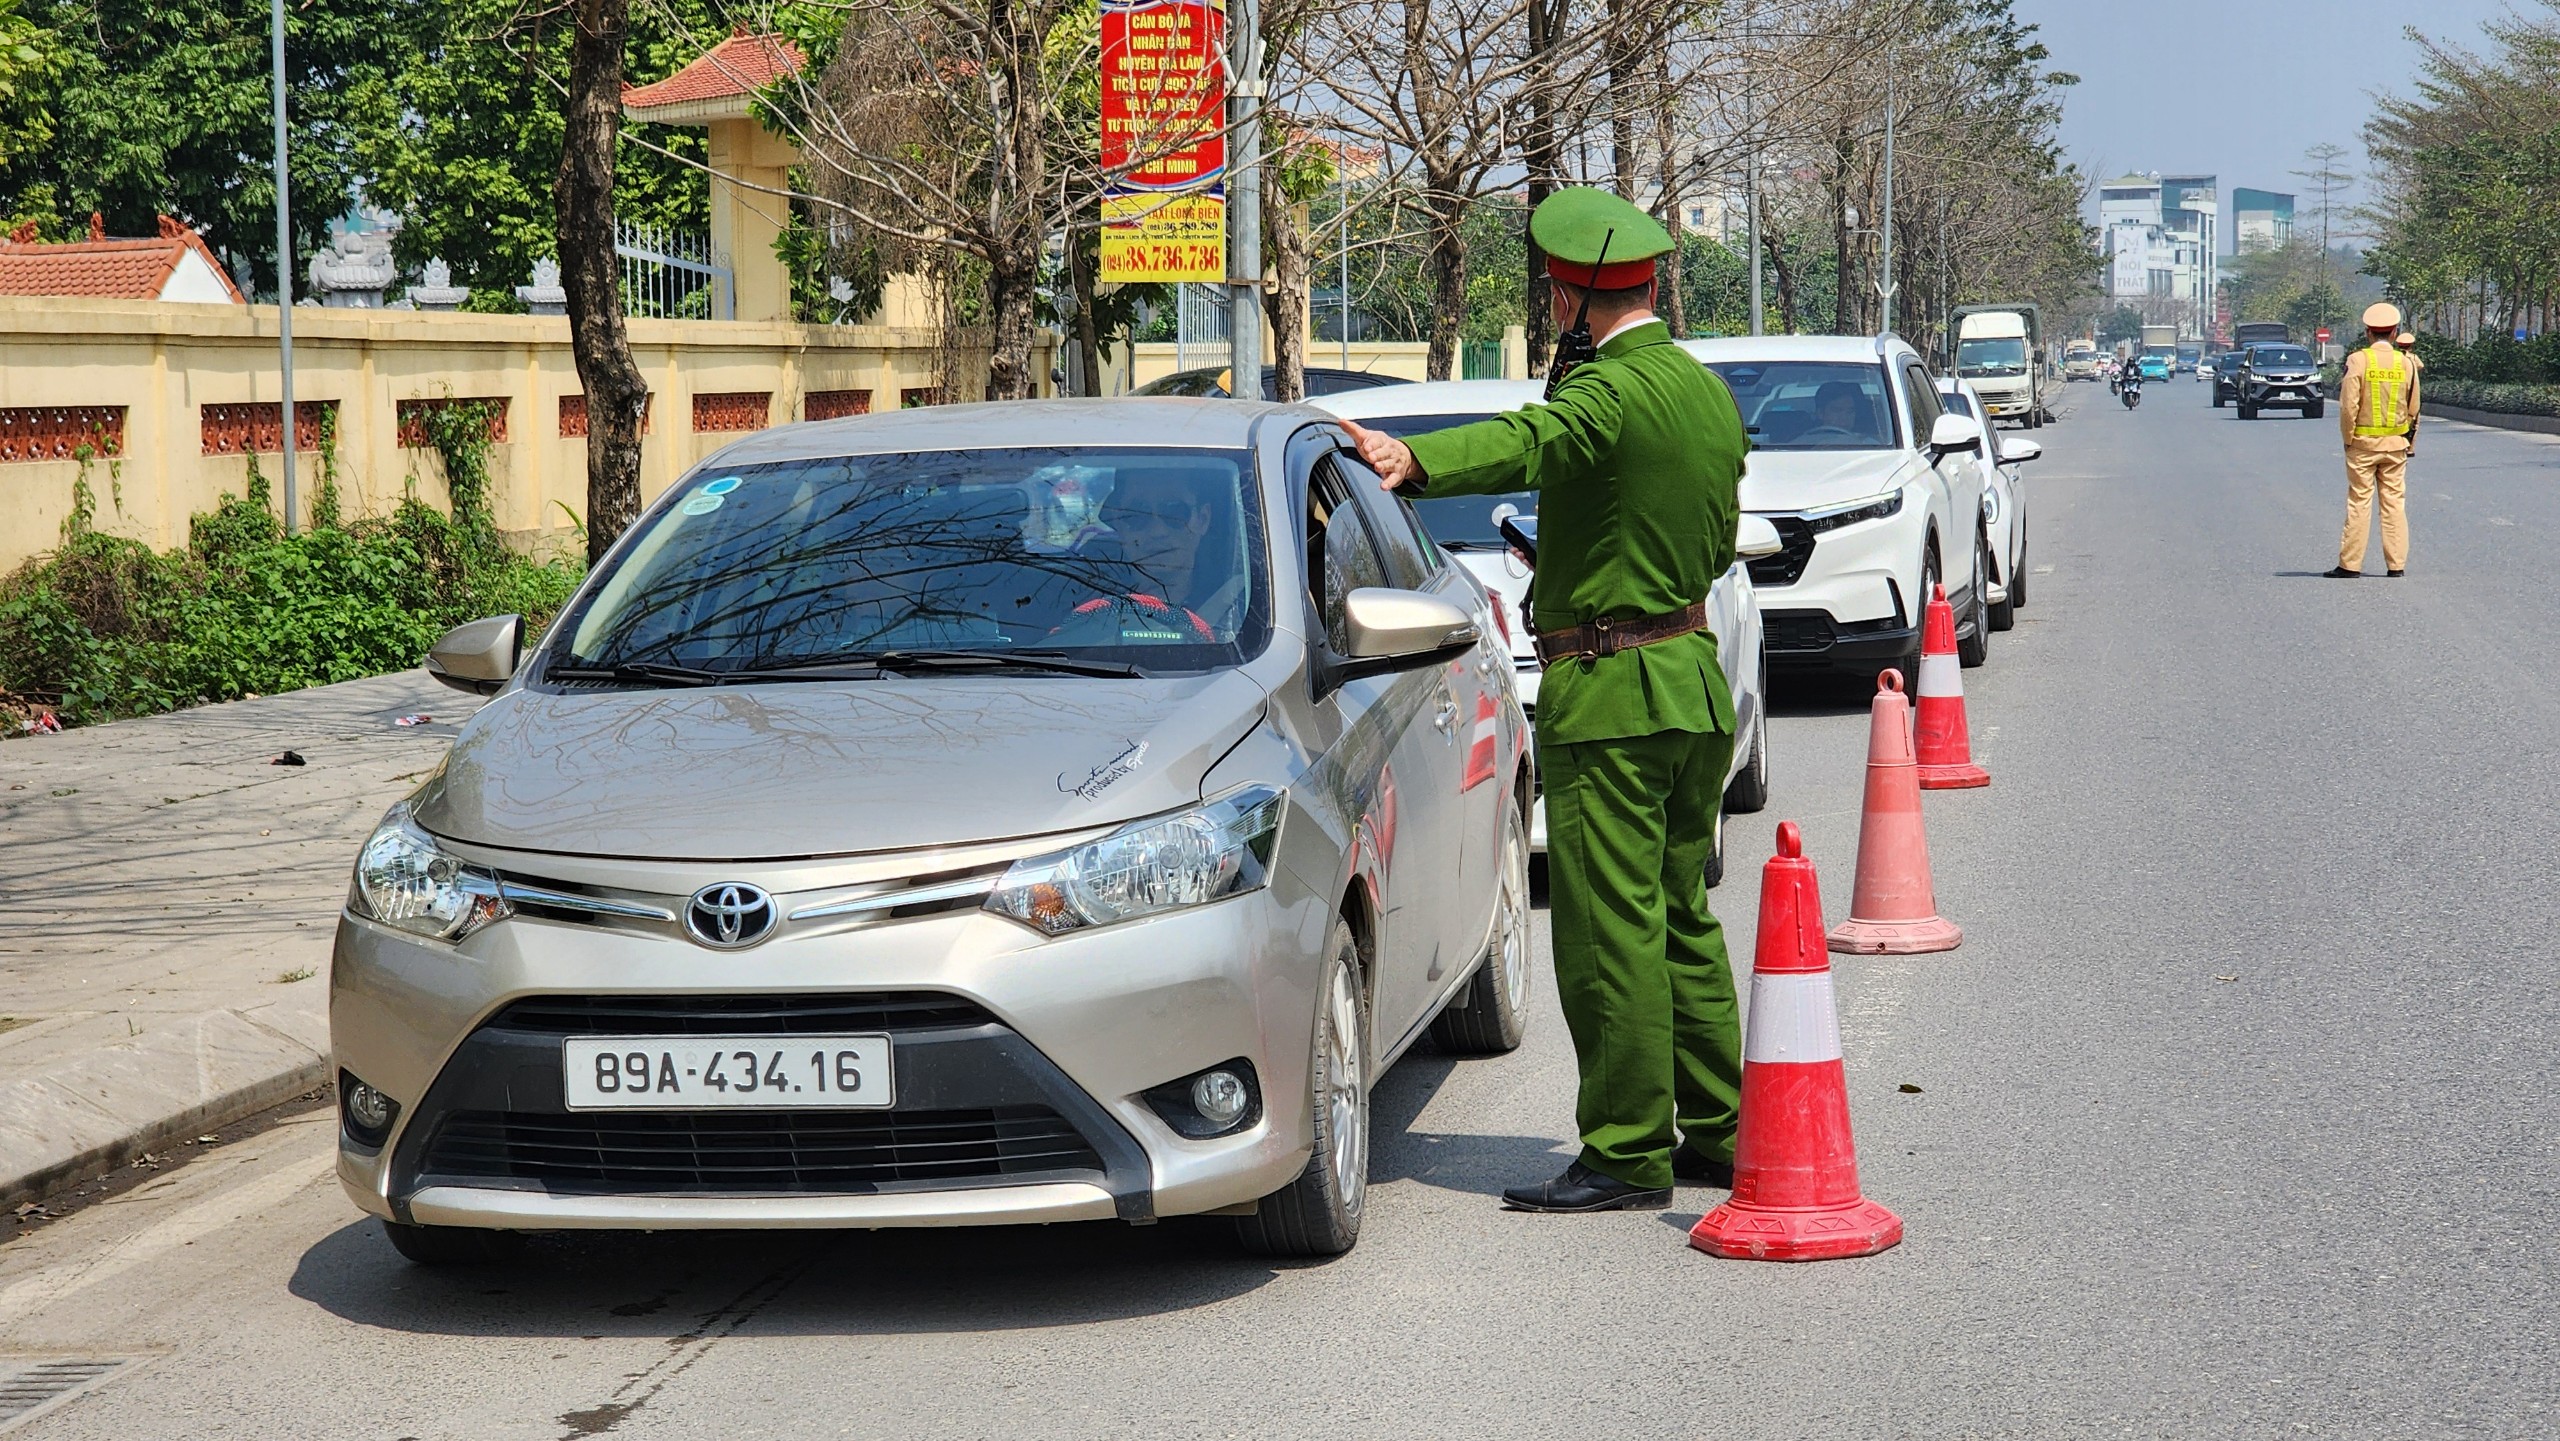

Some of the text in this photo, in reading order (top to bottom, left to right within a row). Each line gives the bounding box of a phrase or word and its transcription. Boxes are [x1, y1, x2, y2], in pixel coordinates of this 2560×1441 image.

[1132, 12, 1191, 31] CÁN BỘ VÀ
[1132, 34, 1165, 50] NHÂN
[1180, 54, 1204, 71] LÂM
[1164, 77, 1187, 94] HỌC
[1107, 117, 1122, 133] TƯ
[1145, 158, 1164, 174] CHÍ
[1166, 160, 1197, 174] MINH
[1198, 205, 1220, 220] BIÊN
[595, 1050, 862, 1093] 89A-434.16
